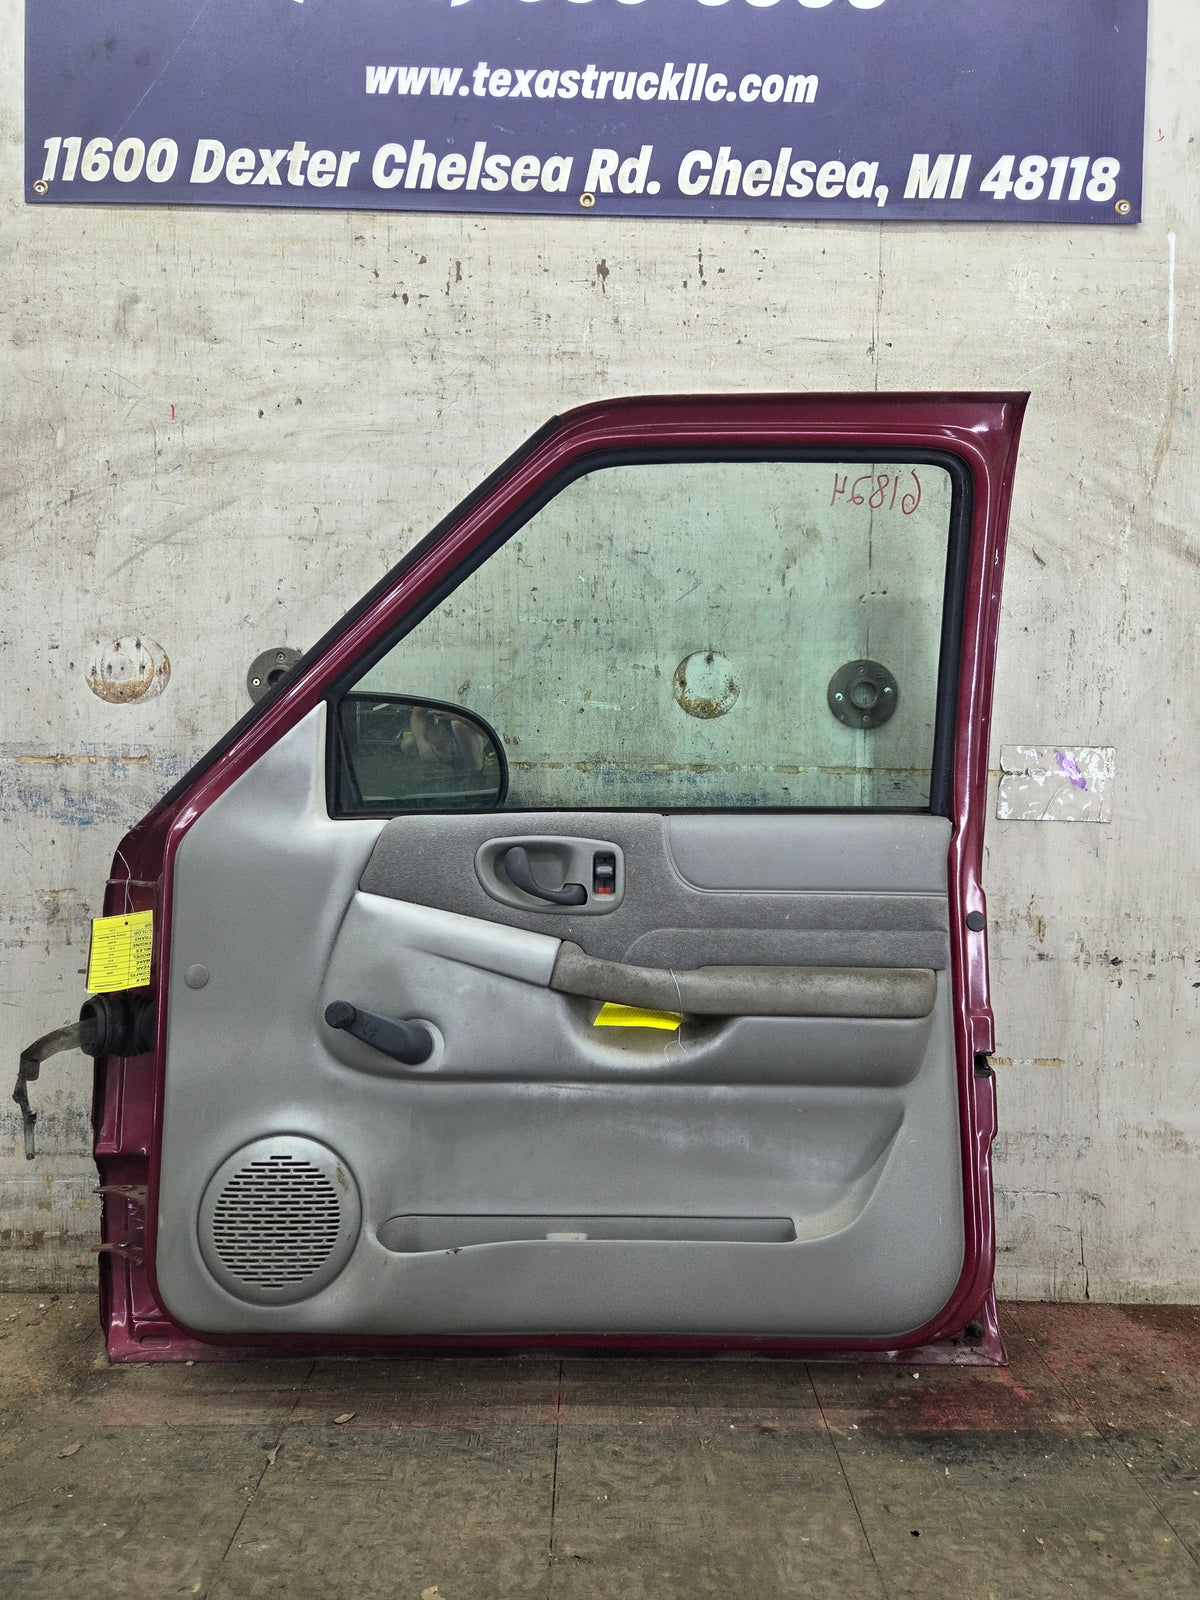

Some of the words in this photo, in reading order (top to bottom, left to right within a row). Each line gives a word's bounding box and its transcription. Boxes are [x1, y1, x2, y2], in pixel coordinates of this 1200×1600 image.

[365, 62, 818, 103] www.texastruckllc.com
[41, 137, 178, 183] 11600
[190, 139, 360, 187] Dexter
[372, 140, 573, 193] Chelsea
[583, 145, 660, 195] Rd.
[678, 147, 888, 207] Chelsea,
[904, 154, 972, 199] MI
[980, 155, 1120, 201] 48118
